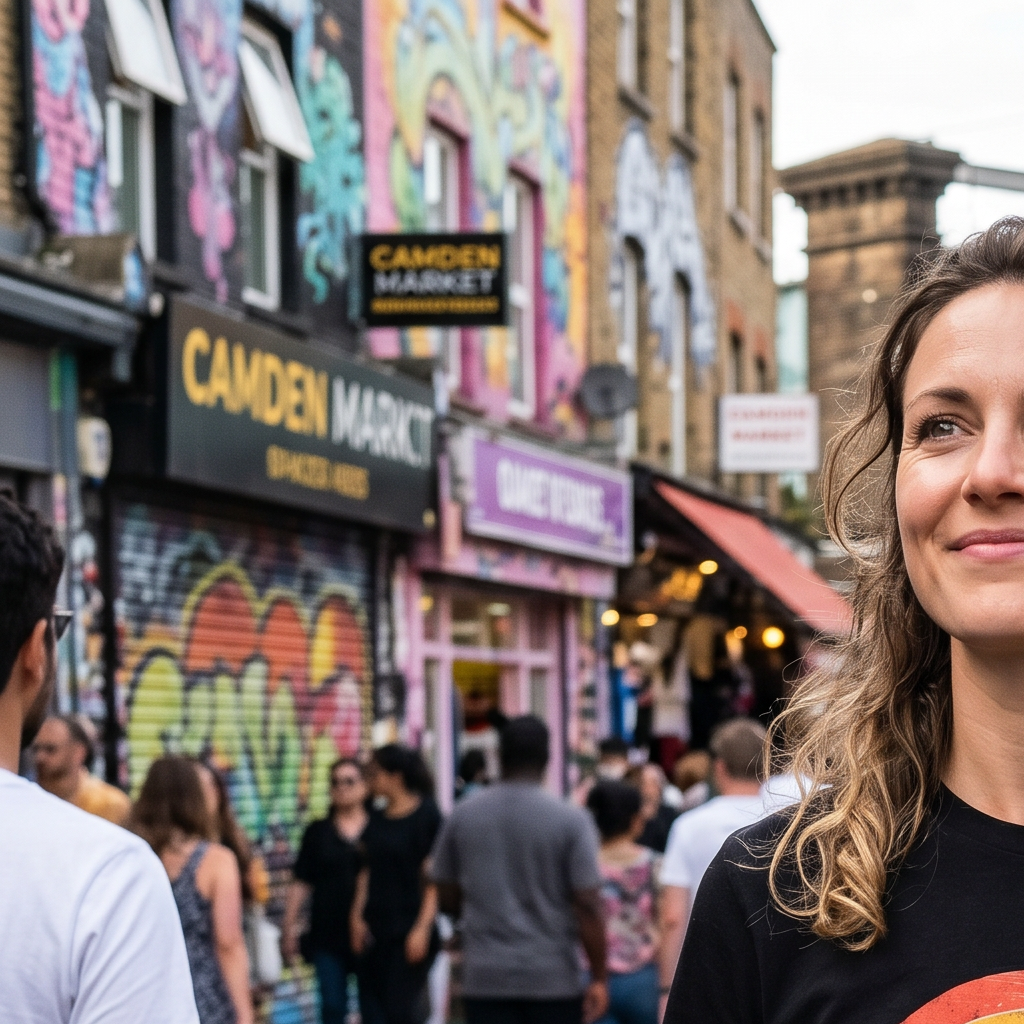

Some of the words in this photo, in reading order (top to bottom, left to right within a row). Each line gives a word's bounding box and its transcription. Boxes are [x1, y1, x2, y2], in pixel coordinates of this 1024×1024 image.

[369, 243, 501, 271] CAMDEN
[373, 268, 498, 296] MARKET
[182, 326, 329, 440] CAMDEN
